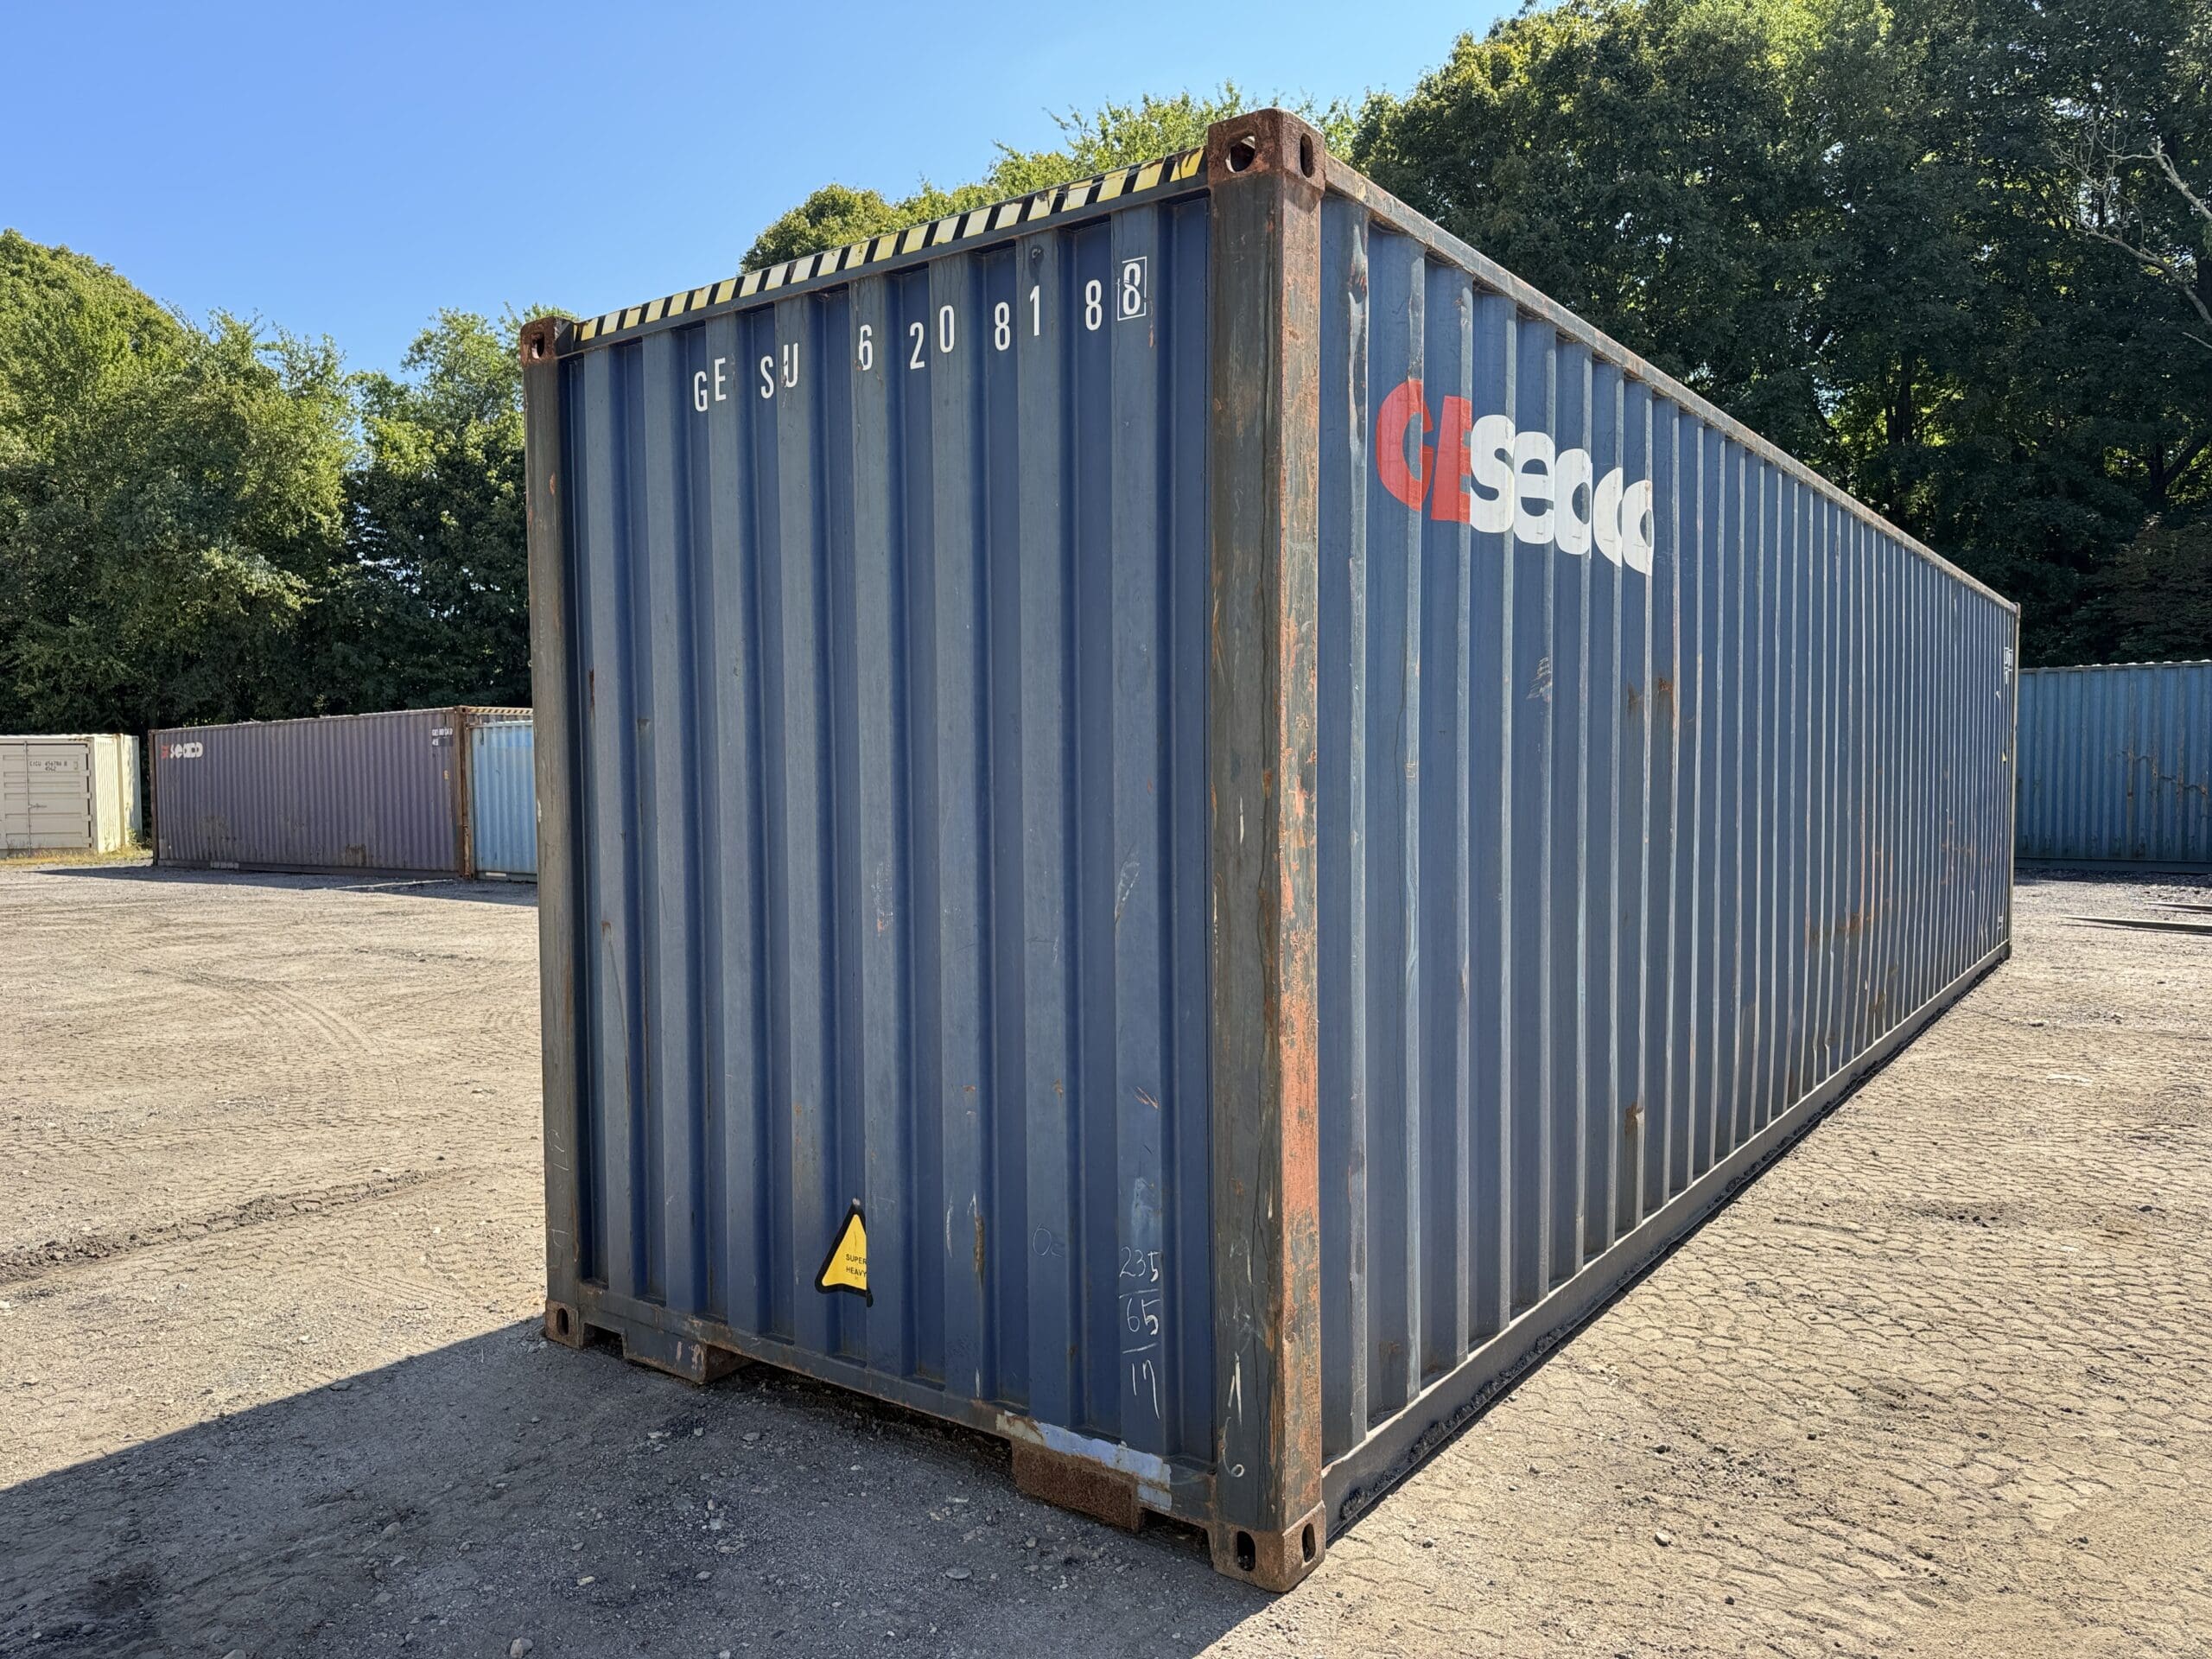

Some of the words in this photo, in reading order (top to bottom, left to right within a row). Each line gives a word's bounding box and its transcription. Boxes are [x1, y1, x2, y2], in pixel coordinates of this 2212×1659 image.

[845, 1254, 867, 1264] SUPER
[1119, 1246, 1160, 1282] 235
[846, 1267, 867, 1277] HEAVY
[1127, 1298, 1160, 1336] 65
